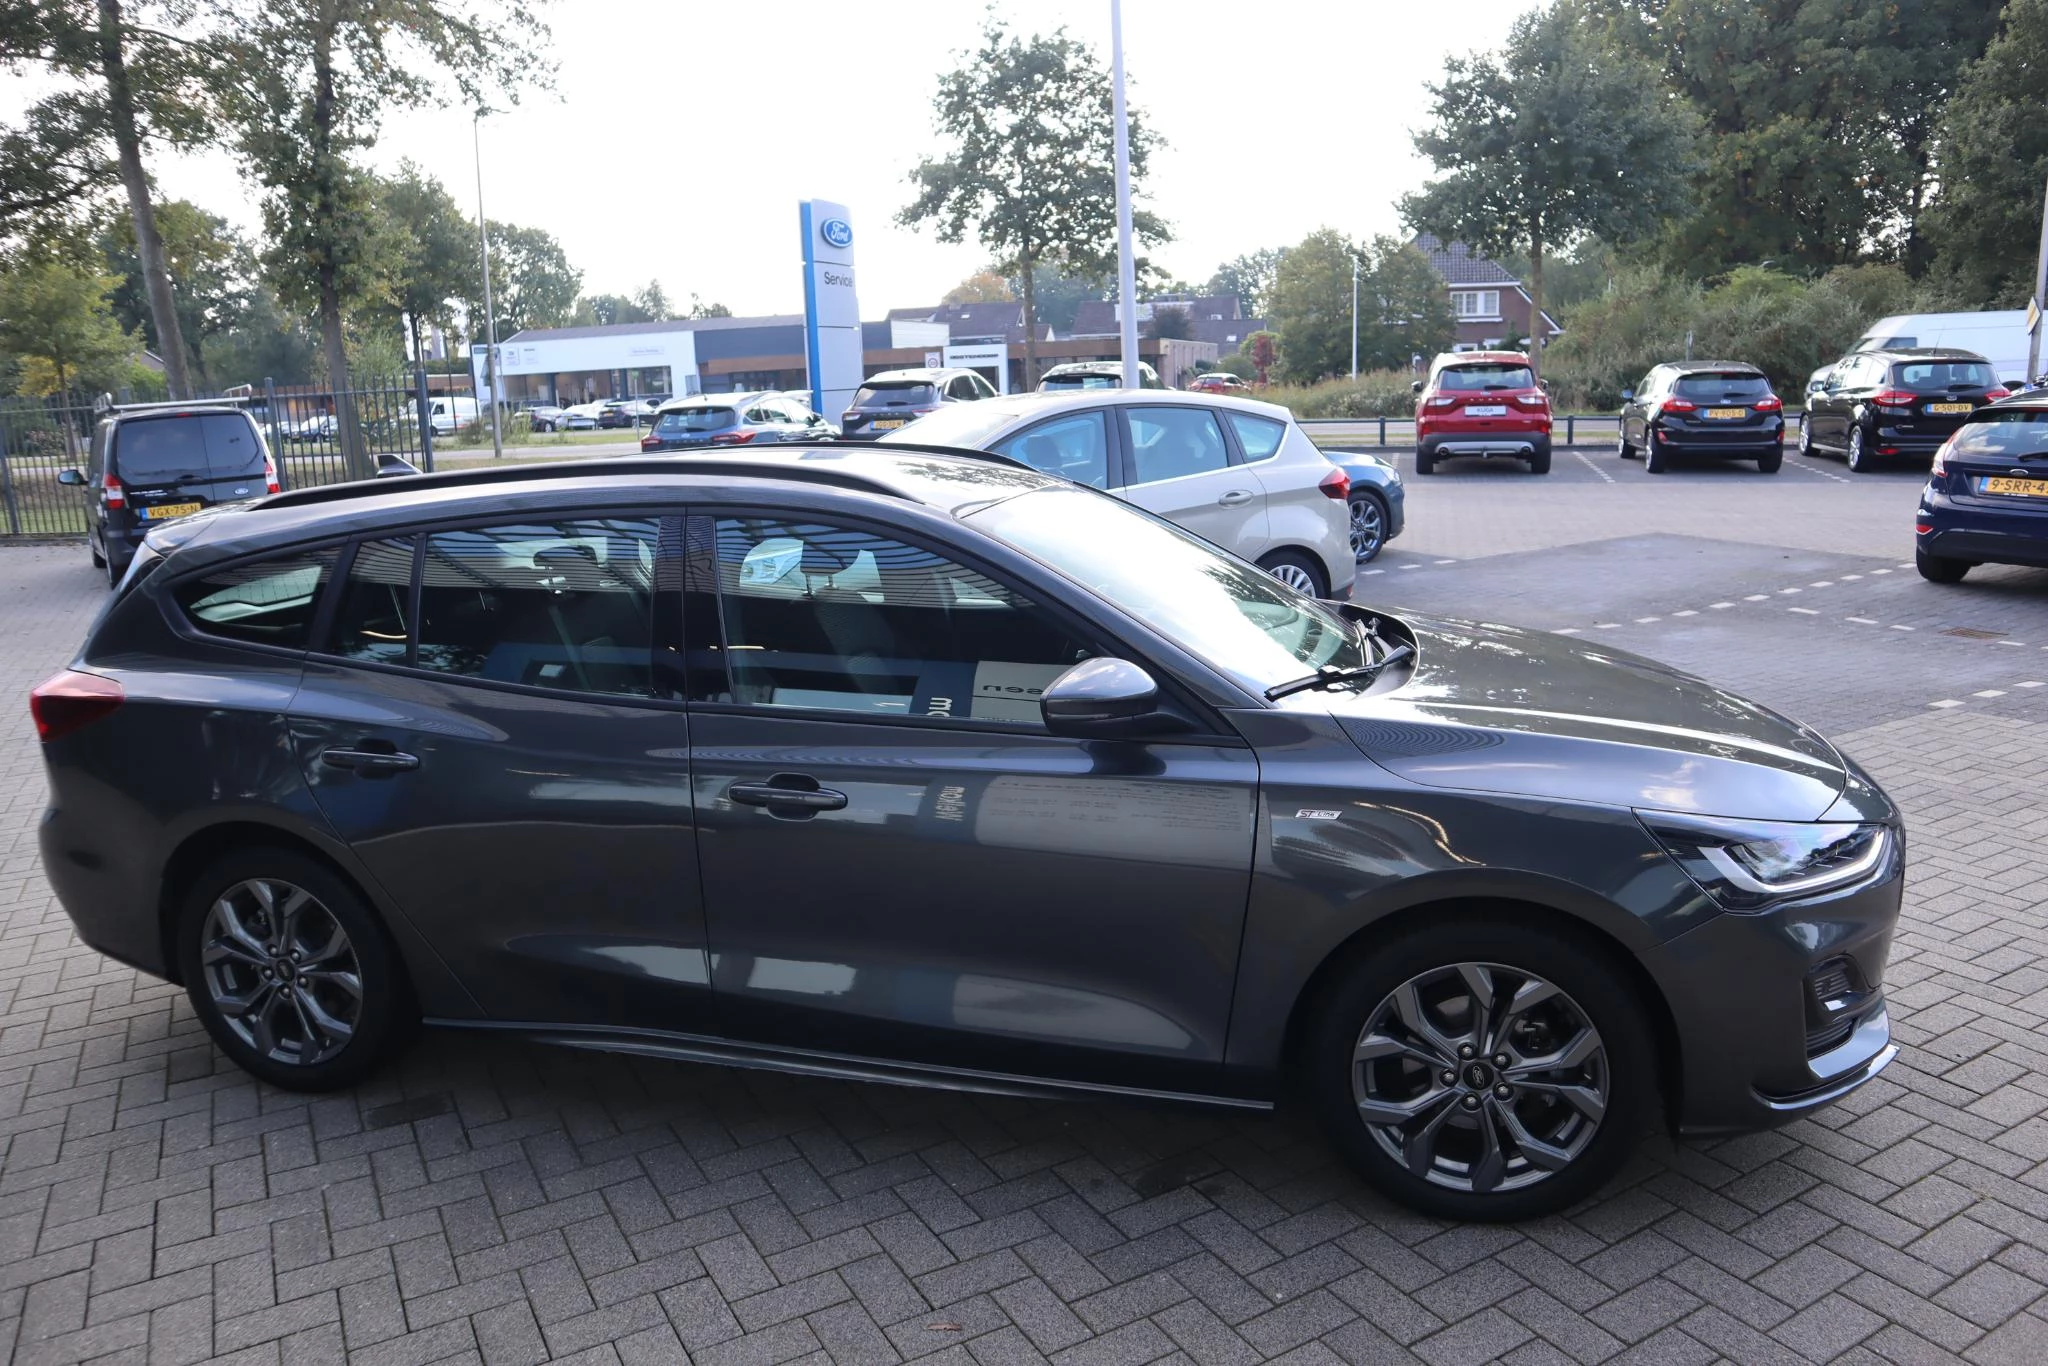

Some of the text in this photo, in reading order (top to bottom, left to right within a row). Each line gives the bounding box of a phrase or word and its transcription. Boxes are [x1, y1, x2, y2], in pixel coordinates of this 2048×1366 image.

[831, 221, 849, 242] Ford
[824, 271, 853, 287] Service
[1992, 479, 2048, 494] 9-SRR-4
